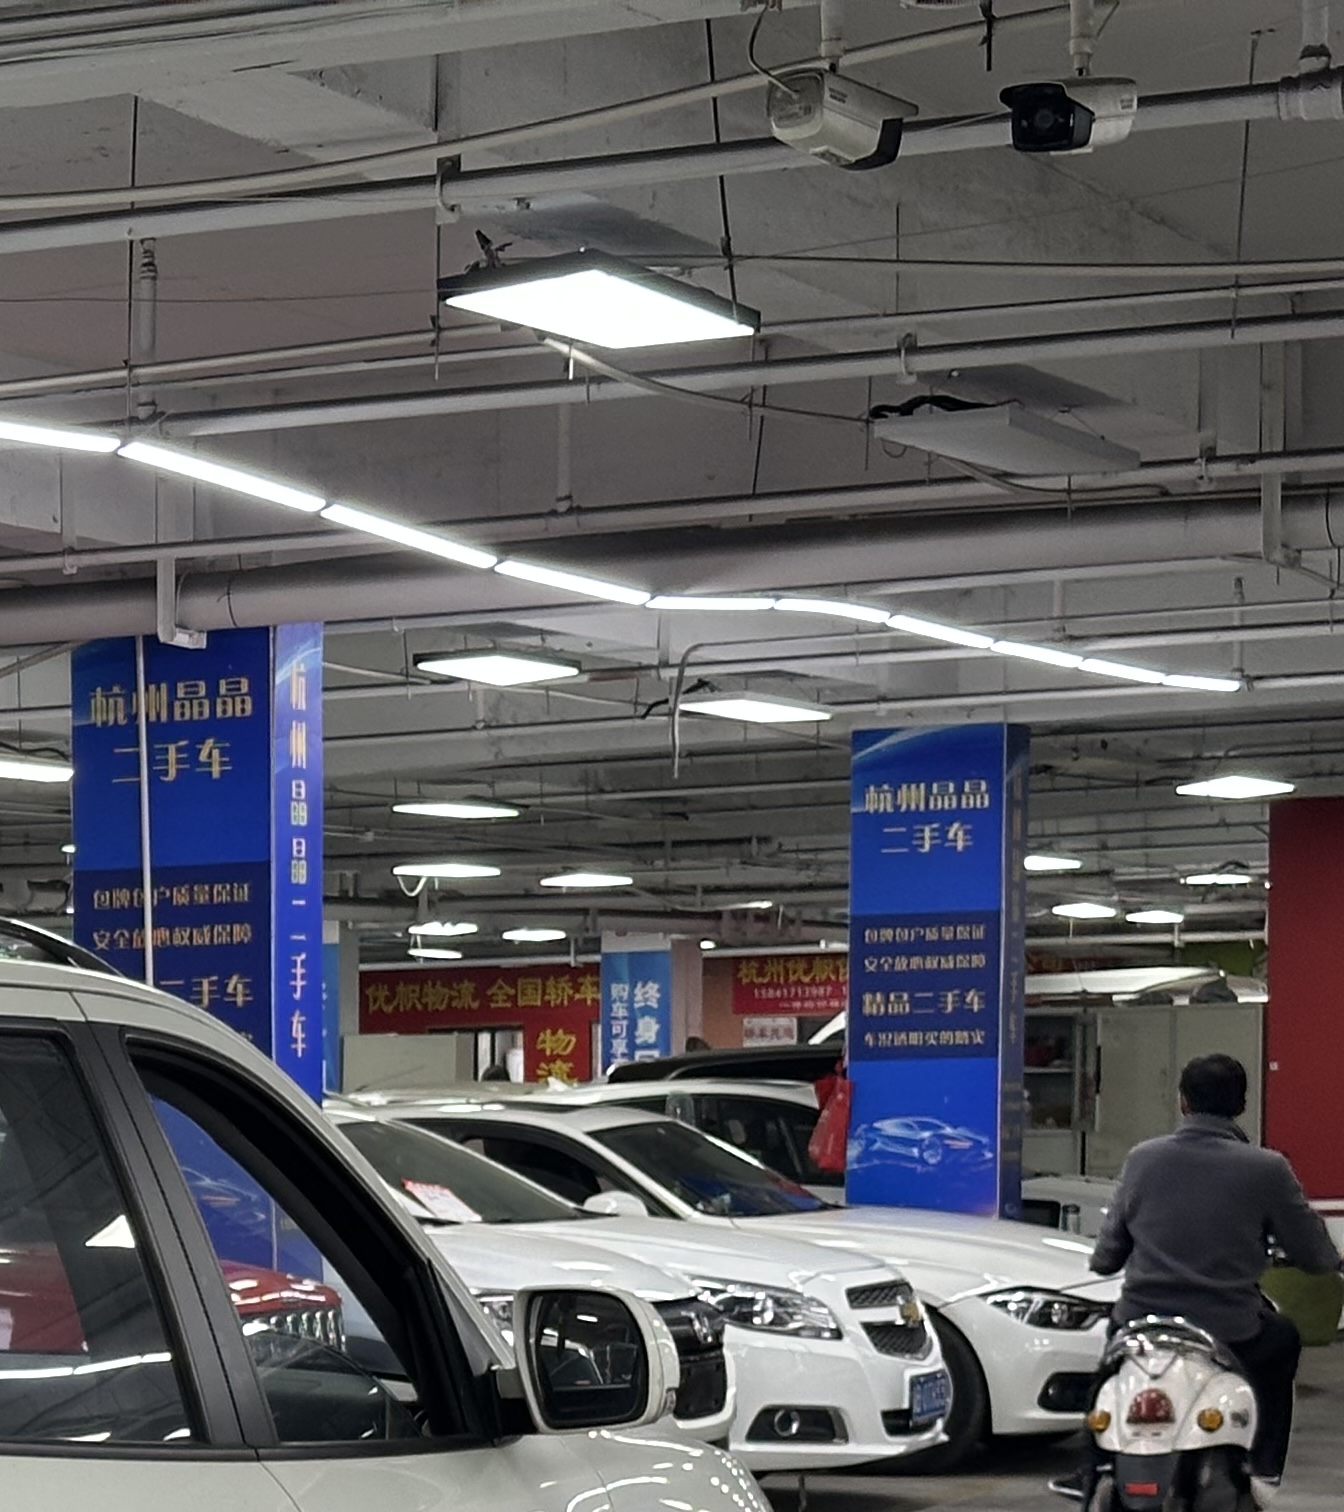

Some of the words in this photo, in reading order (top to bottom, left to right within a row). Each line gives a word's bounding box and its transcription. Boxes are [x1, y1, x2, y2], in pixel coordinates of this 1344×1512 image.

[89, 678, 253, 727] 杭州晶晶
[112, 738, 233, 782] 二手车
[864, 780, 990, 814] 杭州晶晶
[881, 822, 973, 852] 二手车
[862, 988, 985, 1016] 精品二手车
